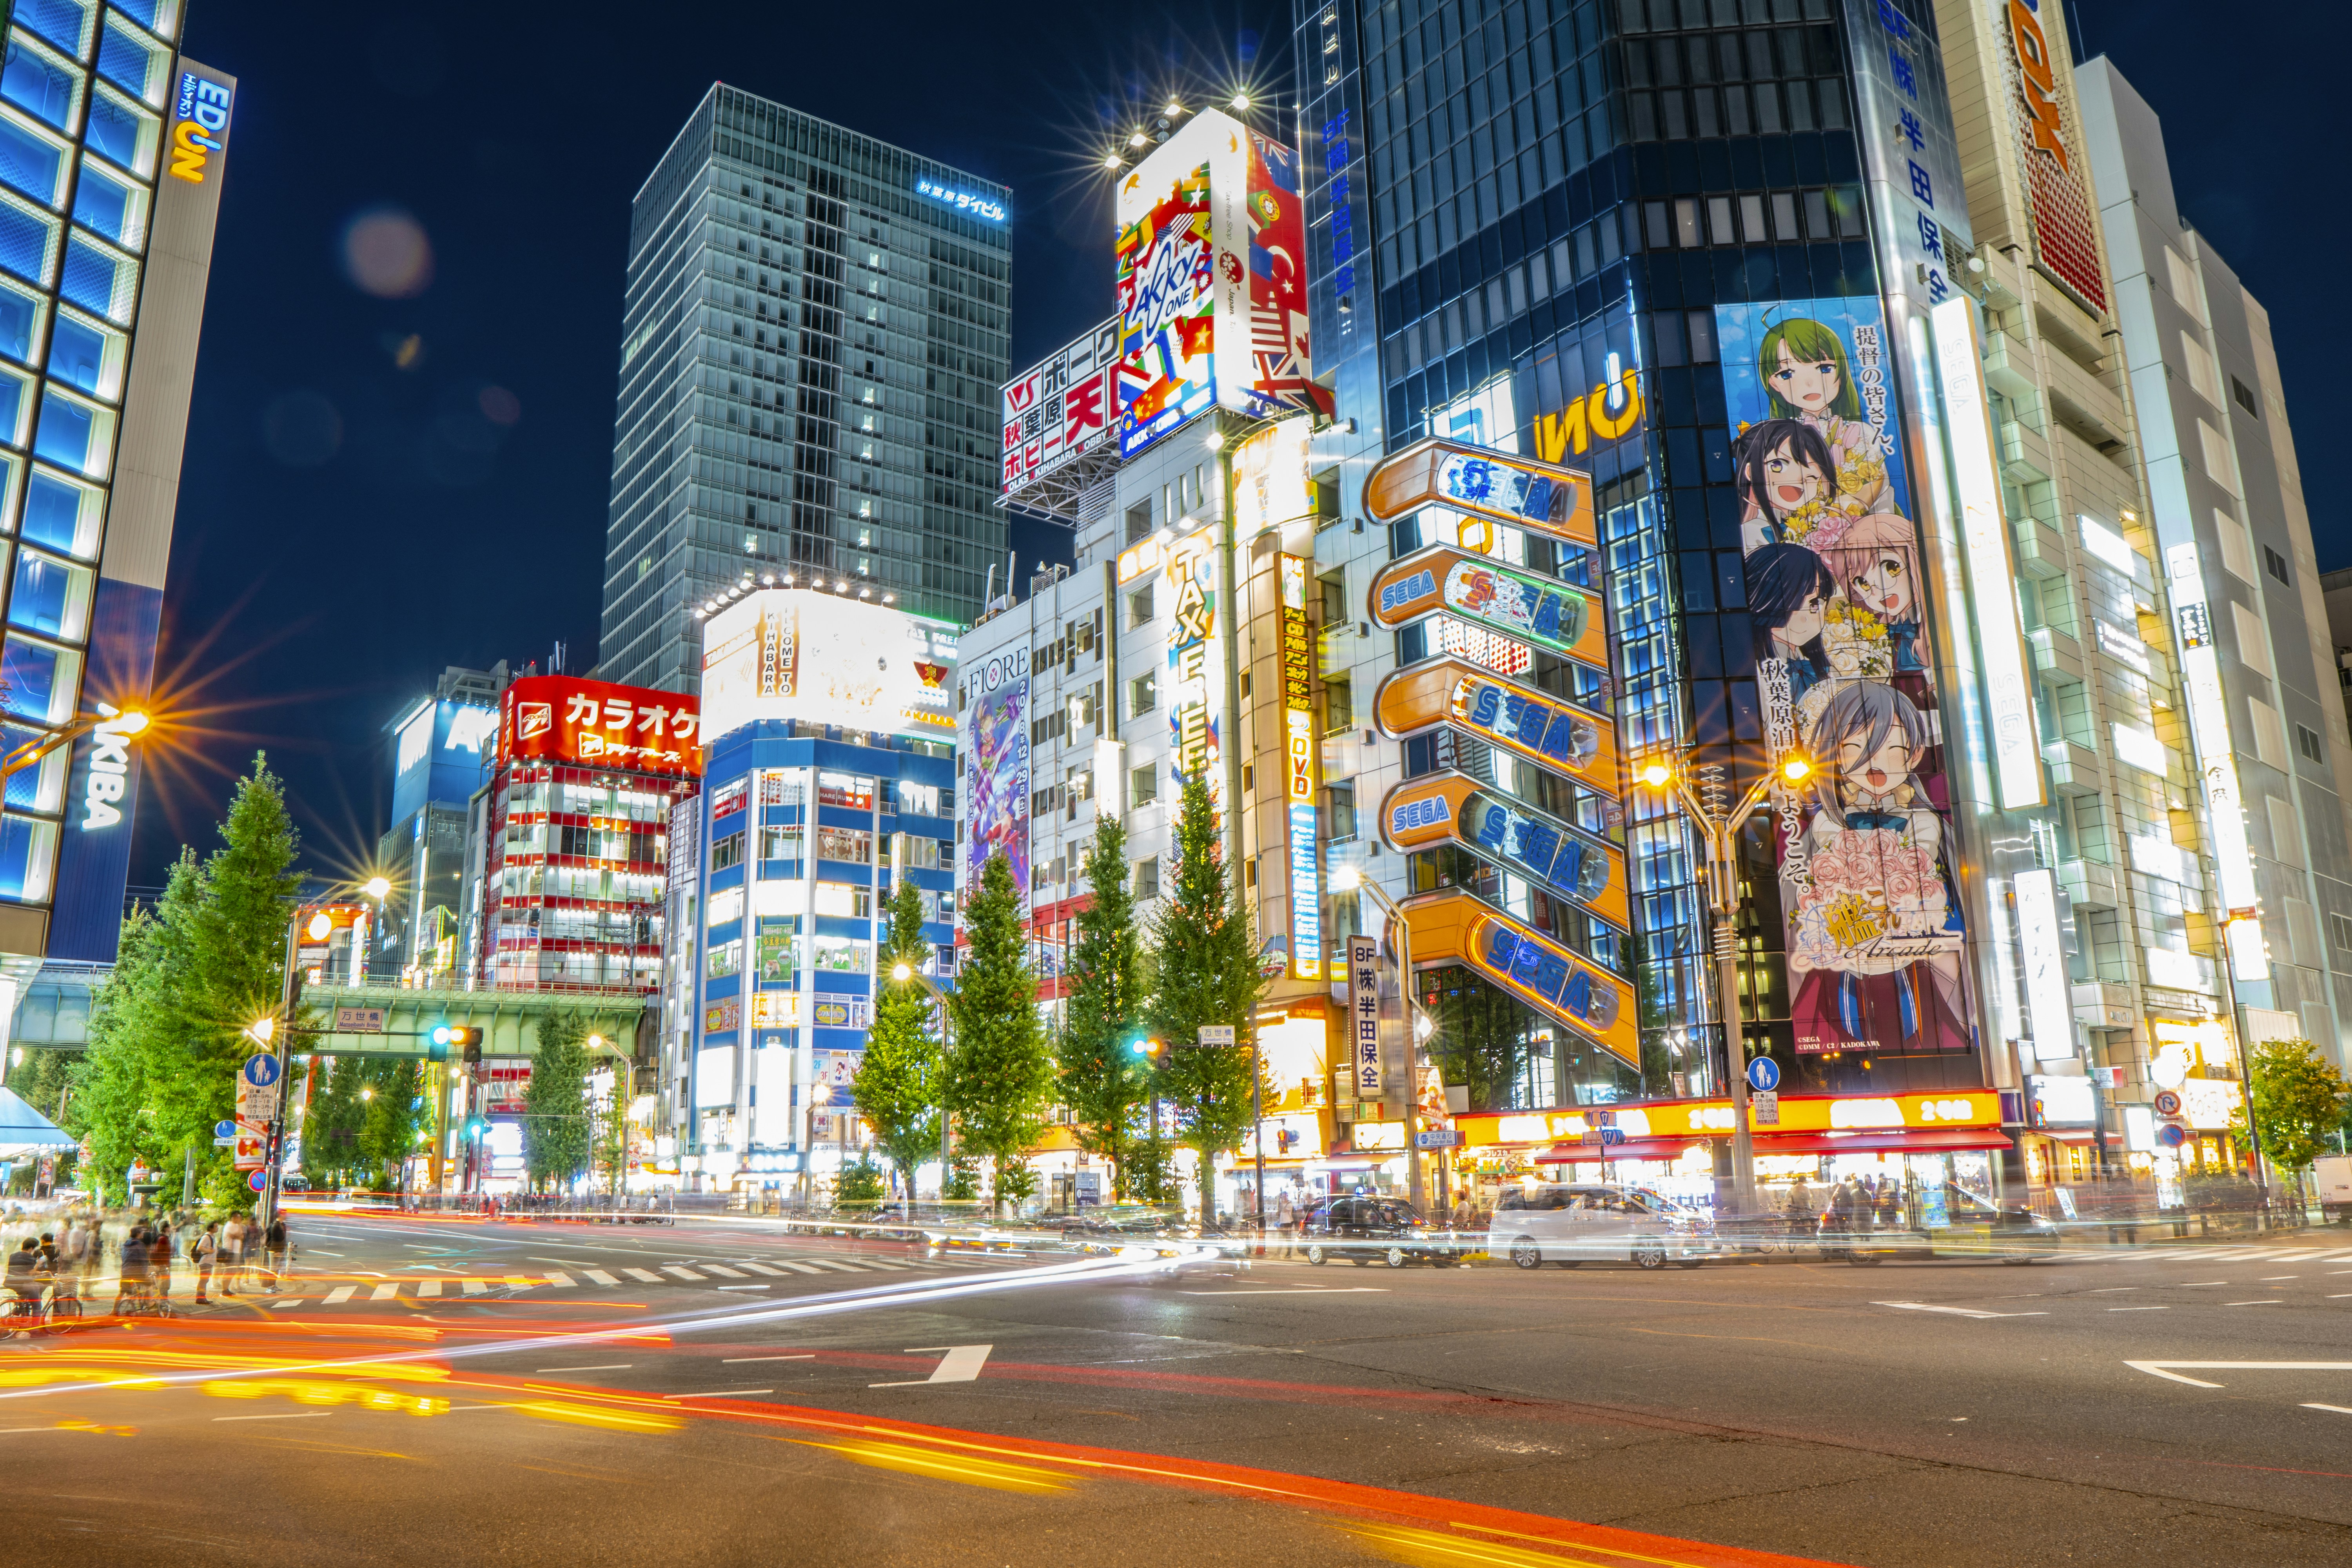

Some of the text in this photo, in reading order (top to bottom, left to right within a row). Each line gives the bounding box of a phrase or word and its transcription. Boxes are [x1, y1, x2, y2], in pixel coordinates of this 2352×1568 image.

[177, 72, 197, 118] エディオン
[169, 79, 230, 183] EDION
[917, 181, 1005, 221] 秋葉原ダイビル
[1165, 286, 1192, 318] ONE
[1853, 325, 1896, 457] 提督の皆さん、
[1005, 394, 1062, 450] 秋葉原
[1004, 434, 1062, 482] ホビー
[1004, 422, 1121, 494] VOLKS AKIHABARA HOBBY PA
[1381, 569, 1436, 613] SEGA
[1284, 607, 1306, 623] ゲーム
[1286, 622, 1304, 637] CD
[764, 612, 775, 693] KIHABARA
[1176, 550, 1209, 777] TAX FREE
[1285, 651, 1308, 666] アニメ
[781, 673, 790, 693] TO
[969, 646, 1030, 700] FIORE
[1287, 681, 1308, 694] ホビー
[565, 693, 700, 739] カラオケ
[900, 708, 958, 728] TAKARAD
[1993, 672, 2026, 757] SEGA
[1016, 680, 1028, 815] 2018年12月29日(土)
[1289, 736, 1312, 799] DVD
[1392, 796, 1452, 834] SEGA
[1843, 936, 1944, 960] Arcade
[1485, 927, 1592, 1021] SEGA
[341, 1011, 379, 1021] 万世橋
[1355, 946, 1379, 1089] 8F (株)半田保全
[1797, 1036, 1821, 1044] ©SEGA
[1840, 1040, 1881, 1049] KADOKAWA
[814, 1060, 822, 1069] 2F
[820, 1071, 828, 1080] 3F
[1601, 1113, 1608, 1123] 17
[1603, 1131, 1612, 1142] 17
